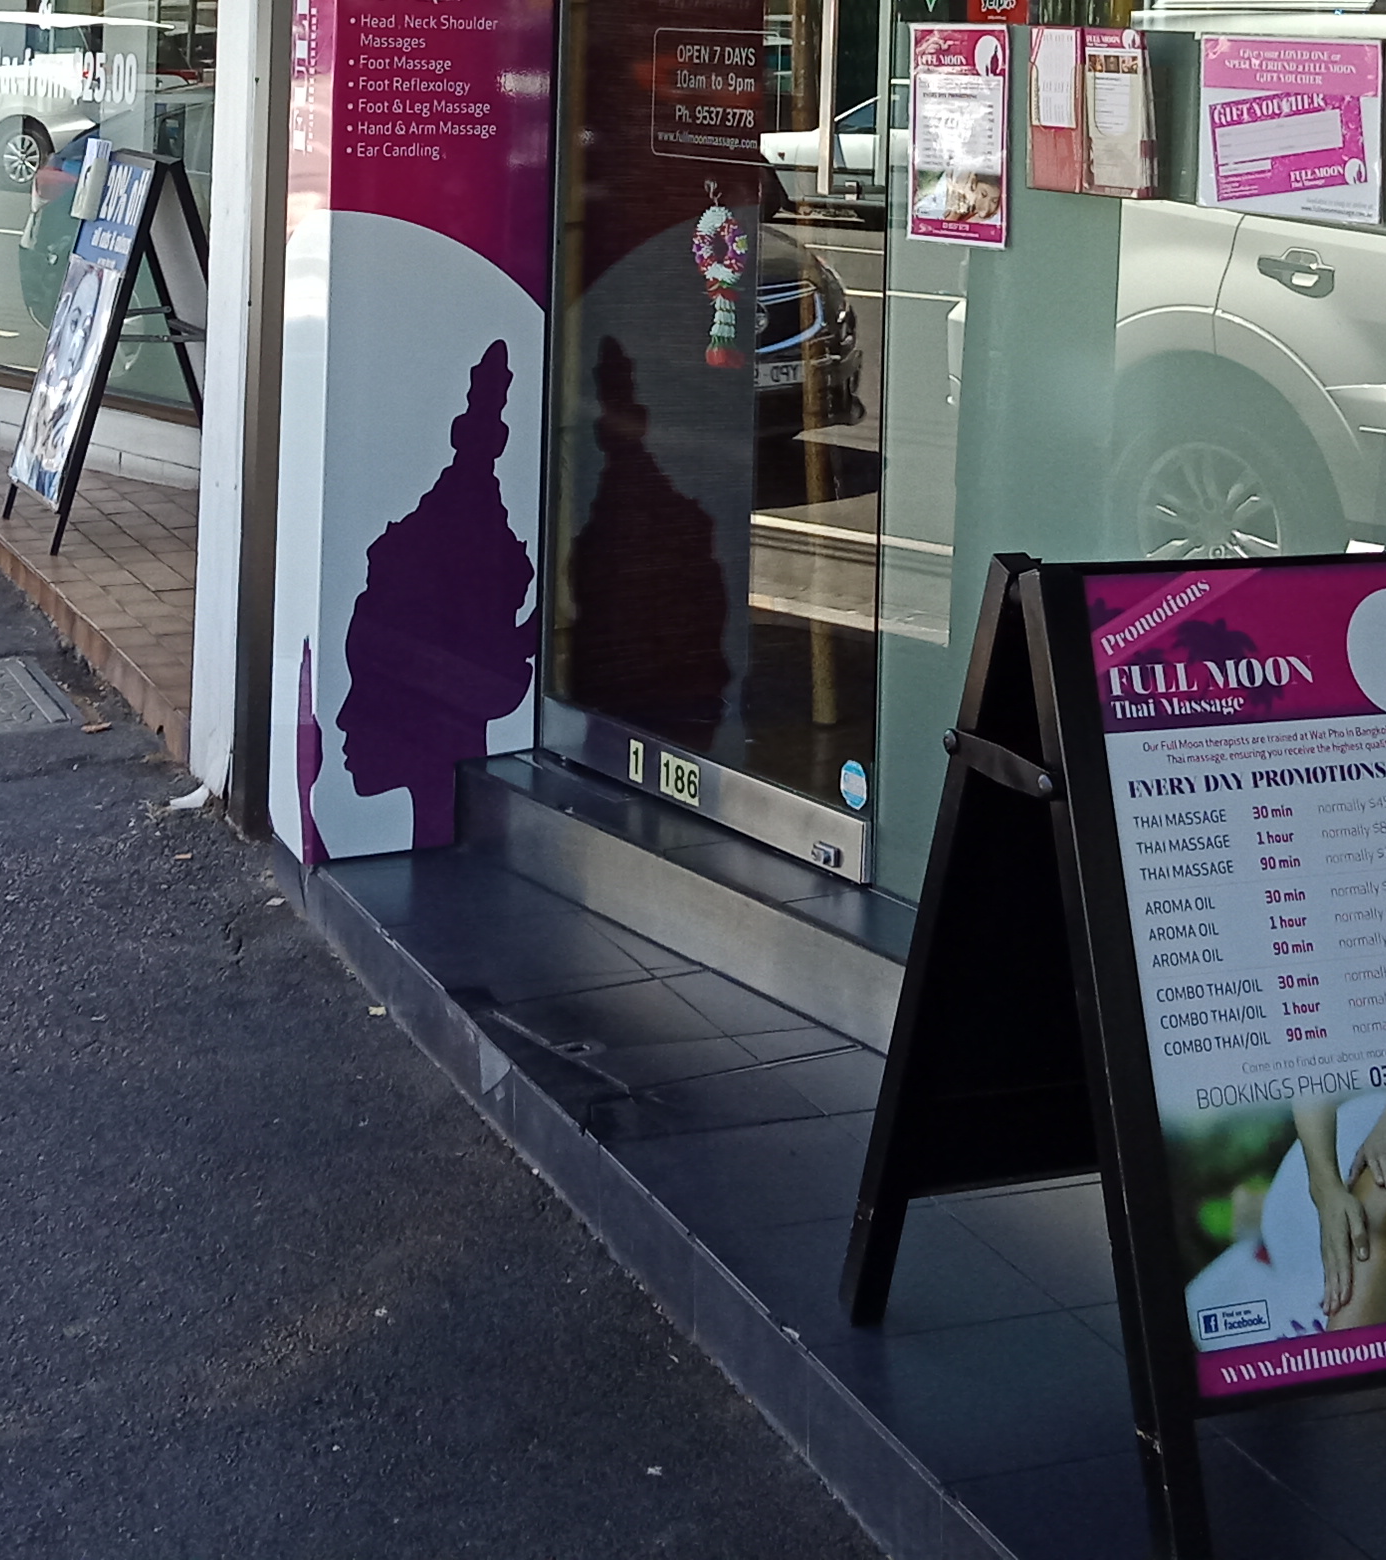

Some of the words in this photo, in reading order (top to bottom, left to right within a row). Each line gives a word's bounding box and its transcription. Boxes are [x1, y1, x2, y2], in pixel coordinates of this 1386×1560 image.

[677, 45, 709, 63] OPEN
[713, 46, 720, 64] 7
[725, 47, 756, 66] DAYS
[71, 48, 138, 105] $25.00
[359, 77, 390, 91] Foot
[393, 77, 470, 96] Reflexology
[676, 70, 706, 88] 10am
[711, 73, 722, 90] to
[728, 73, 754, 95] 9pm
[676, 105, 692, 123] Ph.
[696, 106, 723, 125] 9537
[726, 109, 754, 128] 3778
[1213, 105, 1255, 125] GIFT
[358, 121, 392, 135] Hand
[395, 121, 405, 135] &
[409, 122, 436, 135] Arm
[439, 121, 496, 139] Massage
[357, 143, 379, 157] Ear
[1100, 579, 1211, 656] Promotions
[1109, 662, 1198, 697] FULL
[1202, 655, 1314, 691] MOON
[1110, 698, 1155, 719] Thai
[1159, 695, 1245, 716] Massage
[632, 747, 640, 775] 1
[663, 758, 698, 800] 186
[1128, 776, 1198, 799] EVERY
[1203, 772, 1244, 793] DAY
[1251, 761, 1386, 789] PROMOTIONS
[1133, 815, 1162, 829] THAI
[1165, 809, 1227, 828] MASSAGE
[1252, 805, 1269, 820] 30
[1271, 804, 1293, 818] min
[1318, 798, 1366, 814] normally
[1196, 1079, 1295, 1110] BOOKINGS
[1297, 1069, 1361, 1096] PHONE
